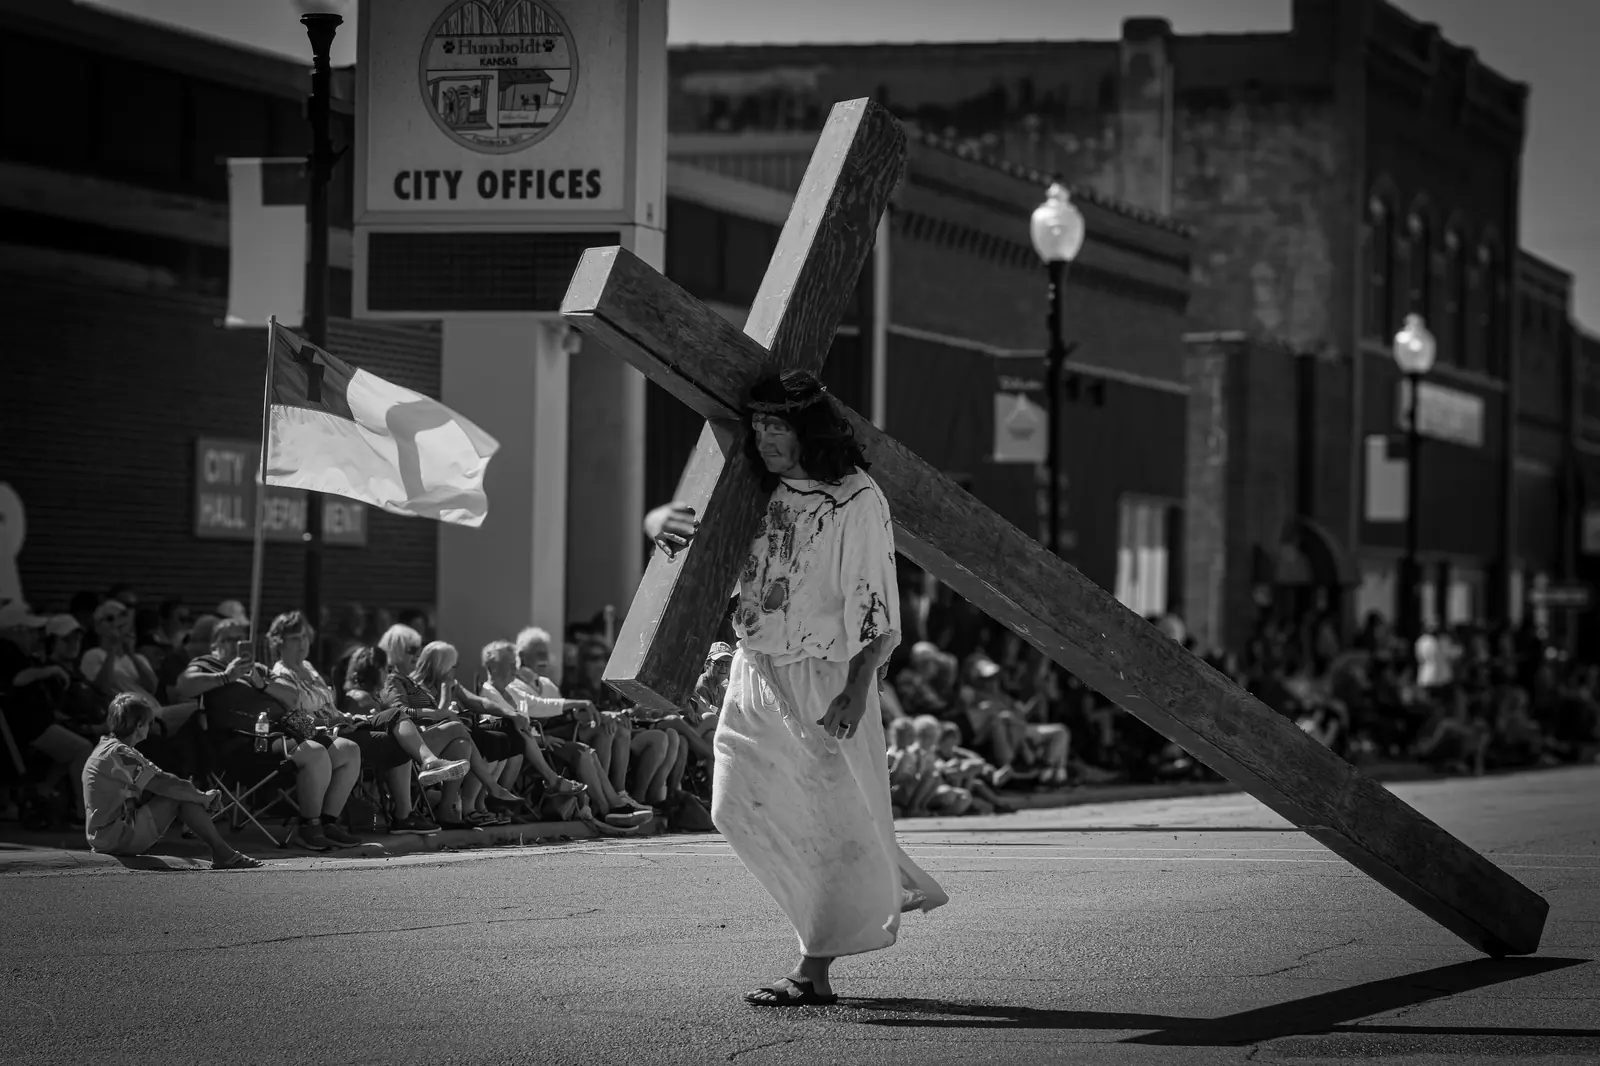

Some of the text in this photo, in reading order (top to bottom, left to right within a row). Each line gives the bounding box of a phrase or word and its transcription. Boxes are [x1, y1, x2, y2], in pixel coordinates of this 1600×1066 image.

[457, 38, 542, 55] Humboldt
[480, 57, 518, 66] KANSAS
[394, 169, 601, 200] CITY OFFICES
[204, 449, 245, 485] CITY
